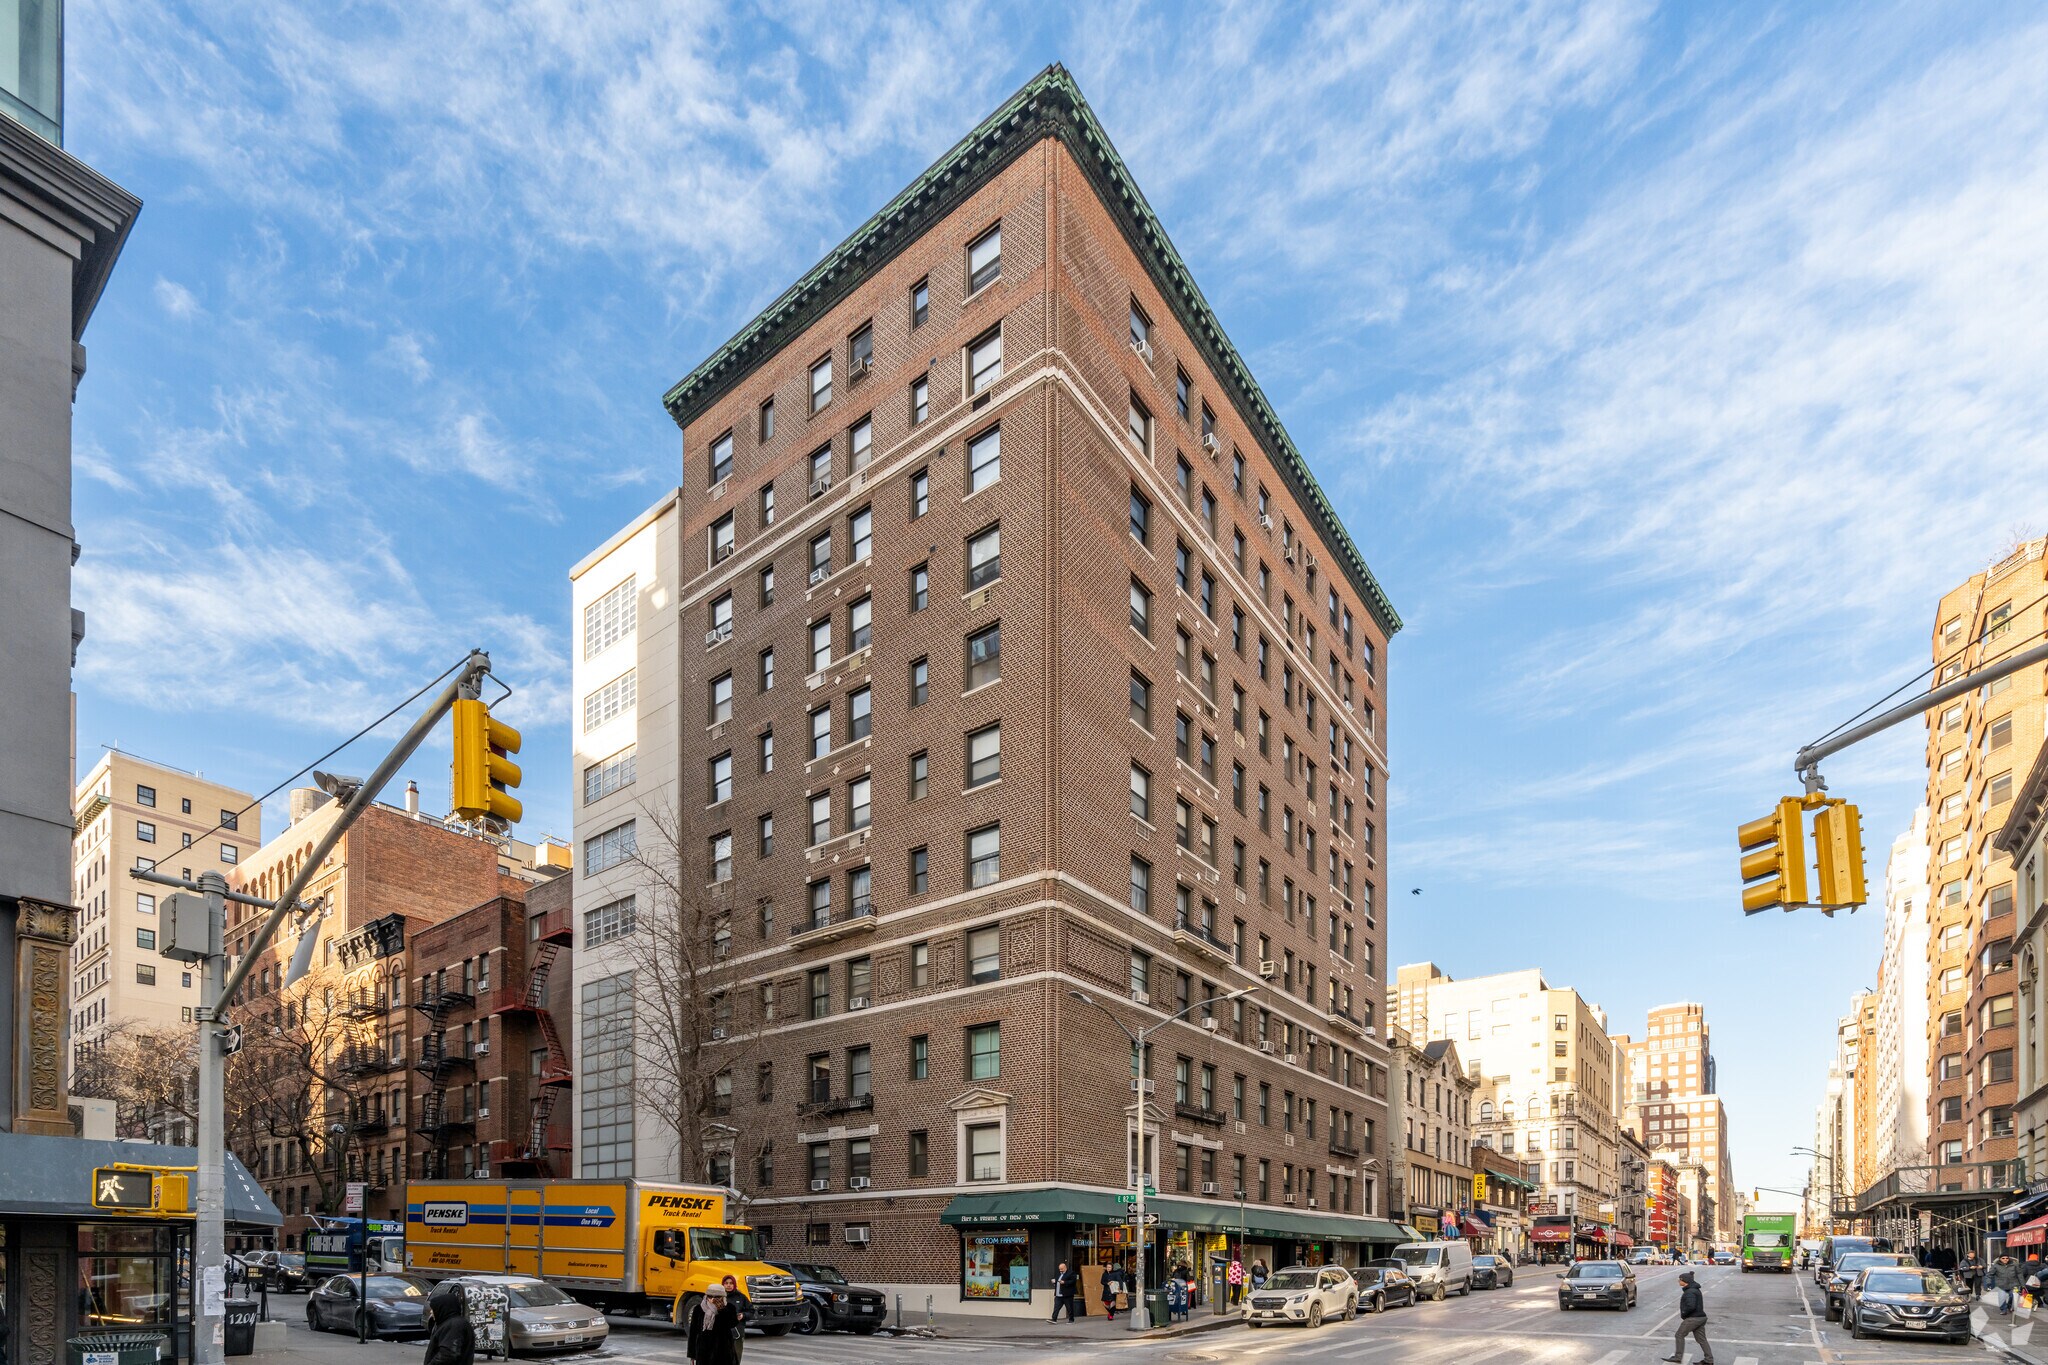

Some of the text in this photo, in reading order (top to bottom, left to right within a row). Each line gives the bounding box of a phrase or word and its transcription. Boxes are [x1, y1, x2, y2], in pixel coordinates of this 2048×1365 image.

[648, 1195, 715, 1210] PENSKE
[1117, 1195, 1121, 1203] E
[1122, 1195, 1130, 1203] 82
[427, 1209, 465, 1218] PENSKE
[580, 1218, 602, 1227] One Way
[228, 1312, 257, 1326] 1204
